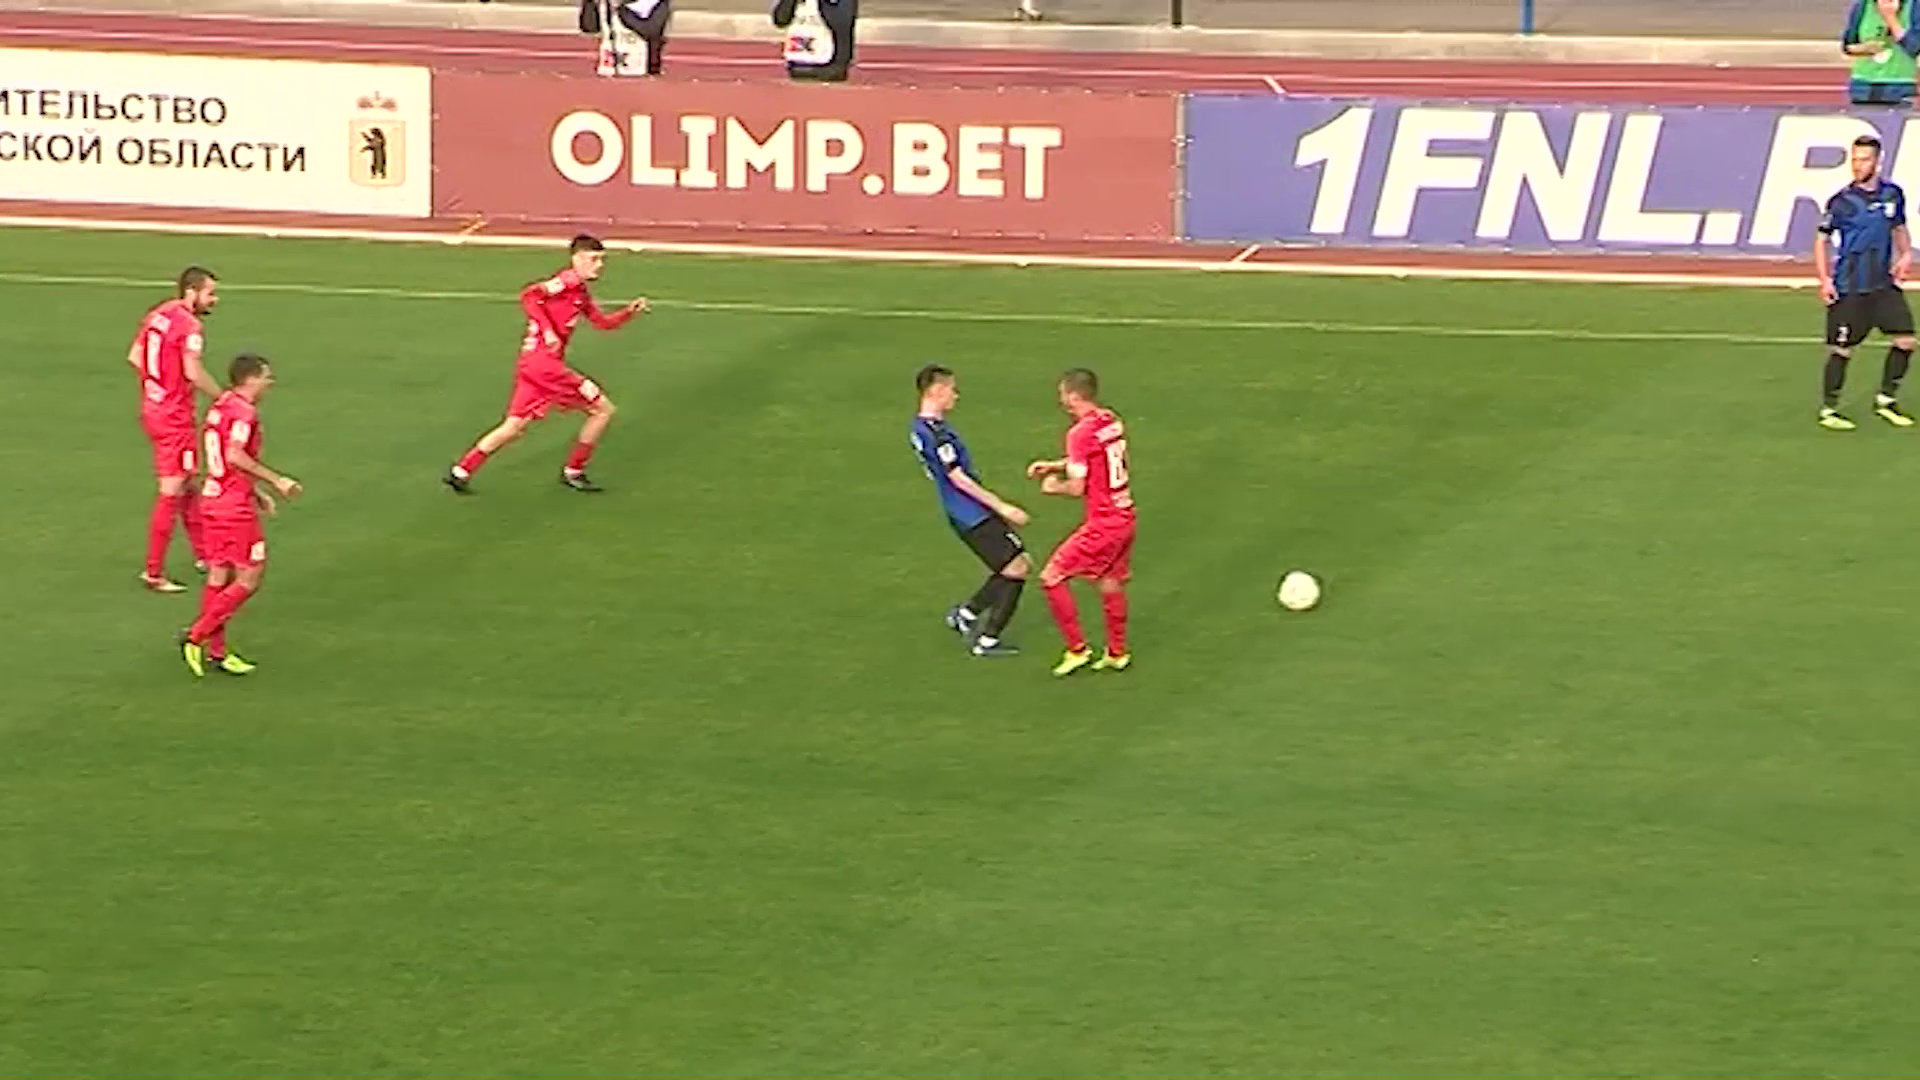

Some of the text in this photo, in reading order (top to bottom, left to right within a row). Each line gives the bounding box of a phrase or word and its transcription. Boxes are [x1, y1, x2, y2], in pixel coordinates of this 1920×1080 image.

[0, 128, 306, 172] СКОЙ ОБЛАСТИ
[551, 110, 1063, 200] OLIMP.BET
